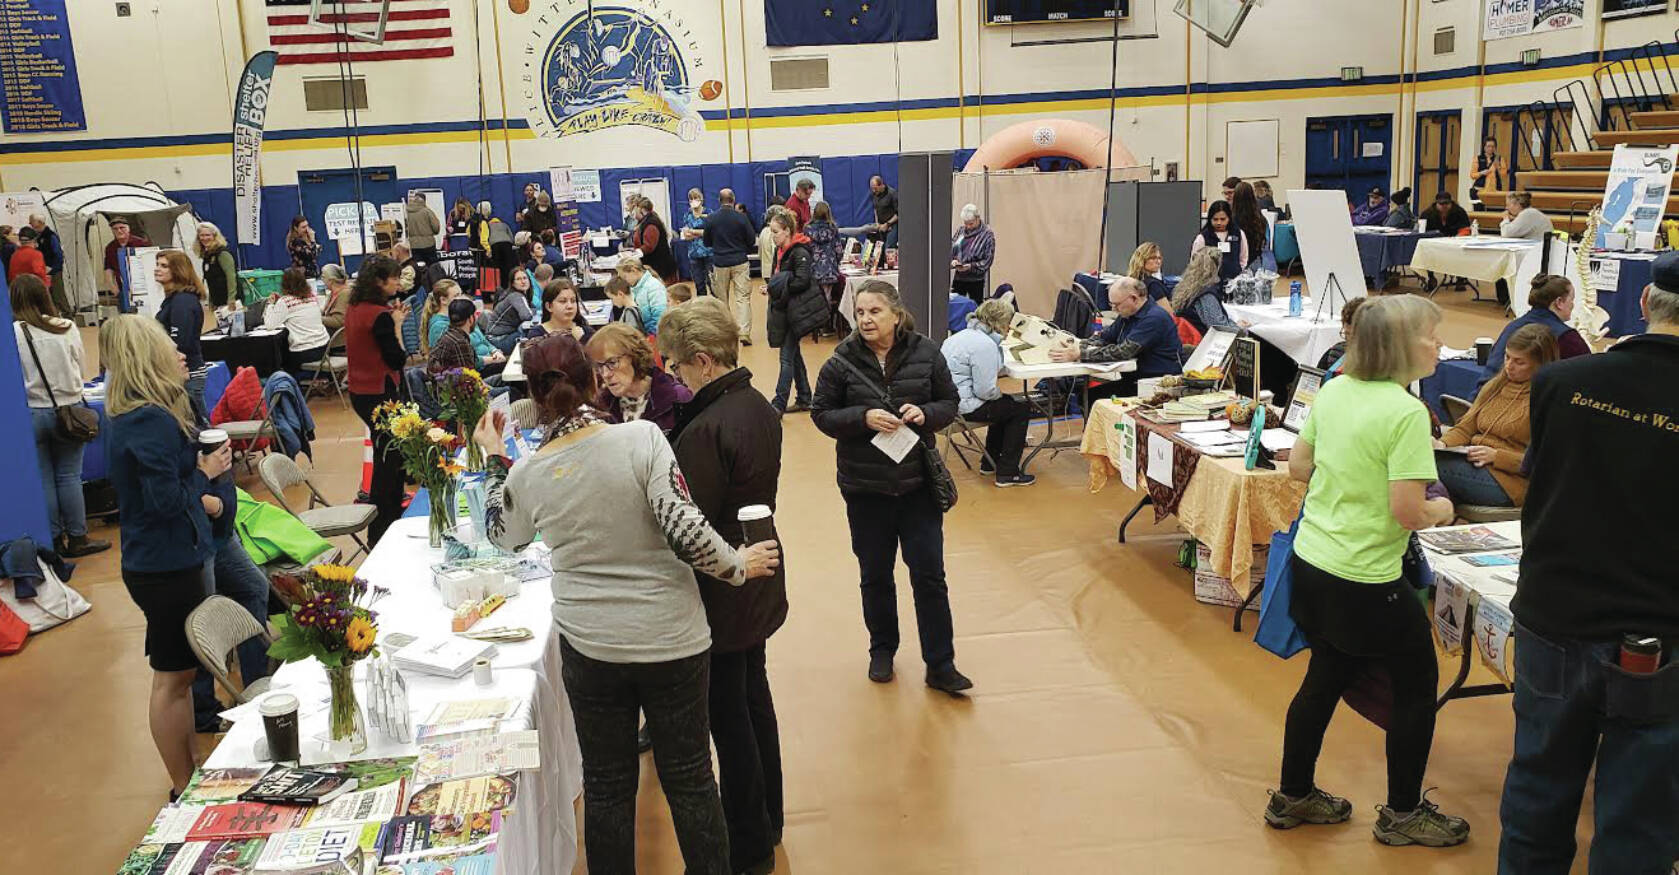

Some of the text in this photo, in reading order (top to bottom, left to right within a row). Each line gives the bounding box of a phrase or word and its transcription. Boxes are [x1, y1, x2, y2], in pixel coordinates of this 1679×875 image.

[993, 9, 1123, 22] SCORE MATCH SCOE
[240, 69, 256, 121] shelter
[249, 72, 272, 126] BOX
[236, 126, 246, 197] DISASTER
[245, 128, 253, 177] RELIEF
[327, 205, 358, 218] PICK
[1570, 391, 1679, 432] Rotarian at Wor
[315, 825, 347, 863] DIET
